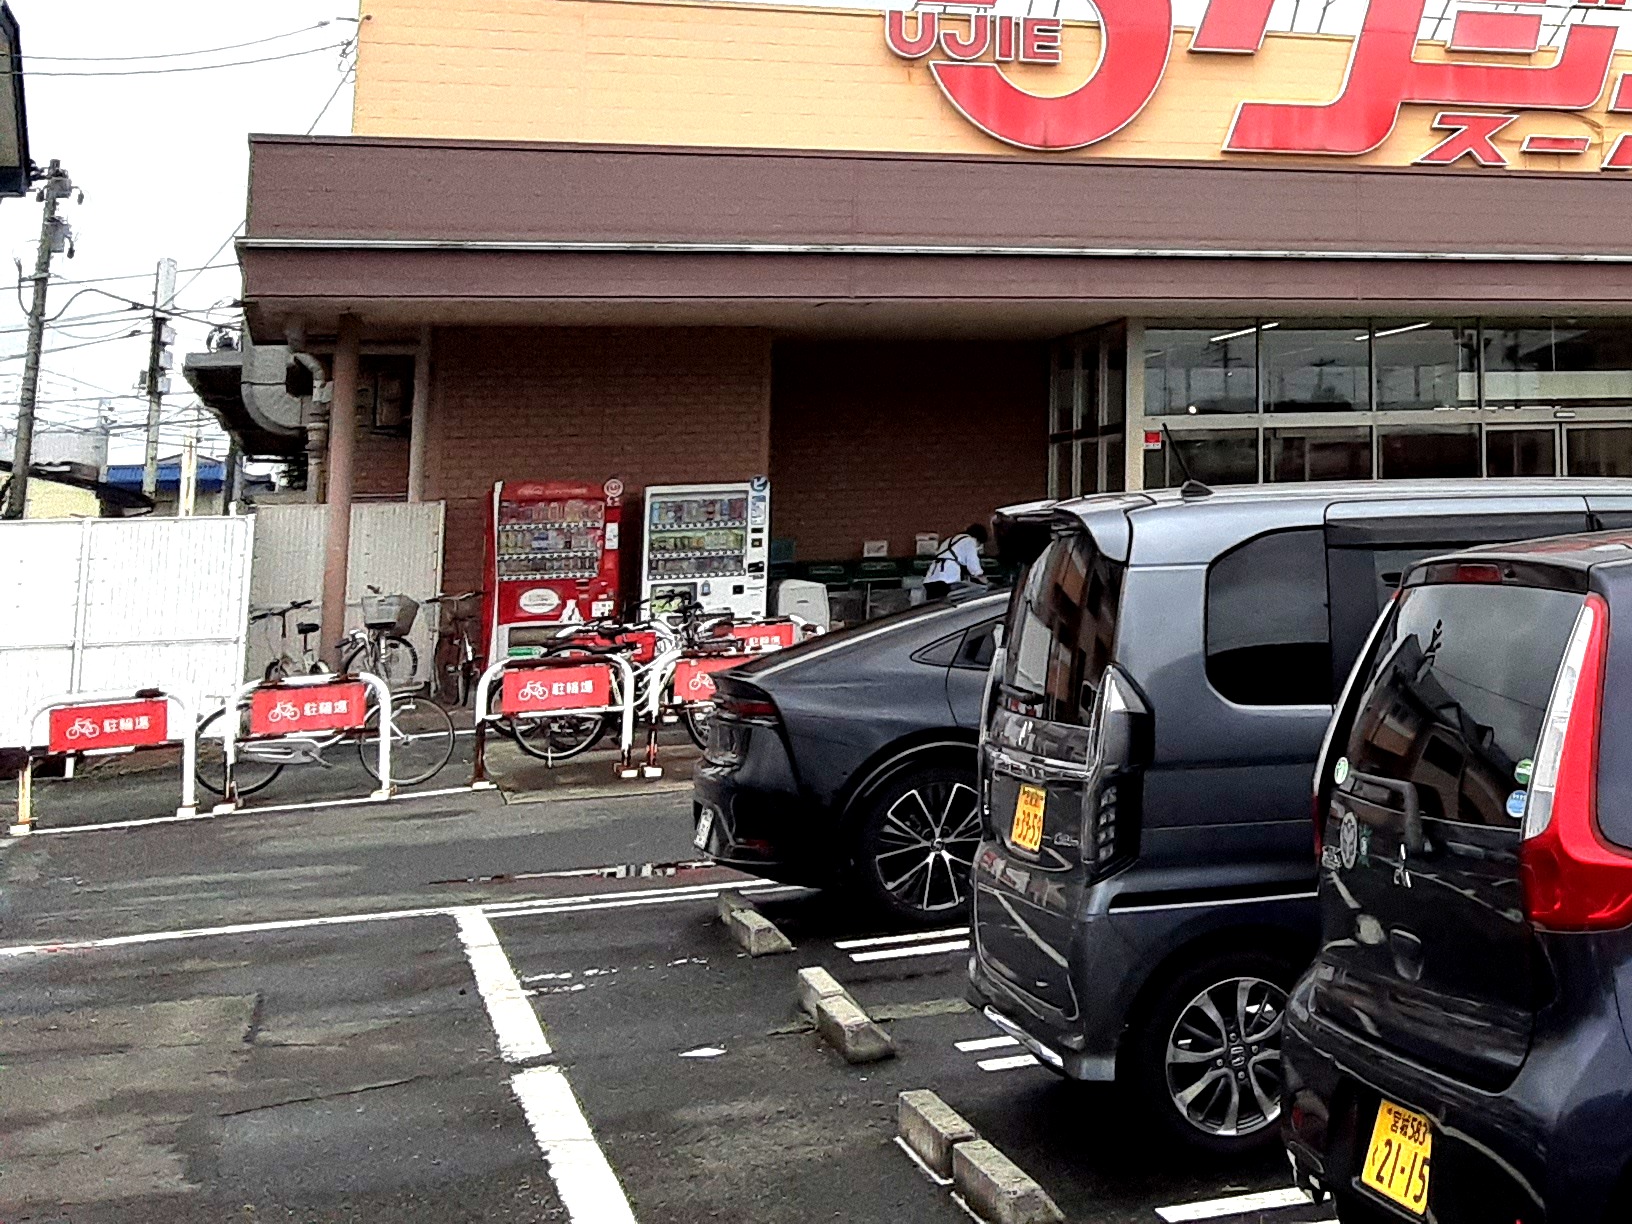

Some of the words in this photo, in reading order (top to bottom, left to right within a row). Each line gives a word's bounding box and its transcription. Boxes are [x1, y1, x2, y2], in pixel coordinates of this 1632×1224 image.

[886, 9, 1063, 65] UJIE
[551, 679, 594, 696] 駐輪場
[303, 699, 349, 717] 駐輪場
[103, 715, 150, 733] 駐輪場
[1375, 1138, 1431, 1204] 21-15
